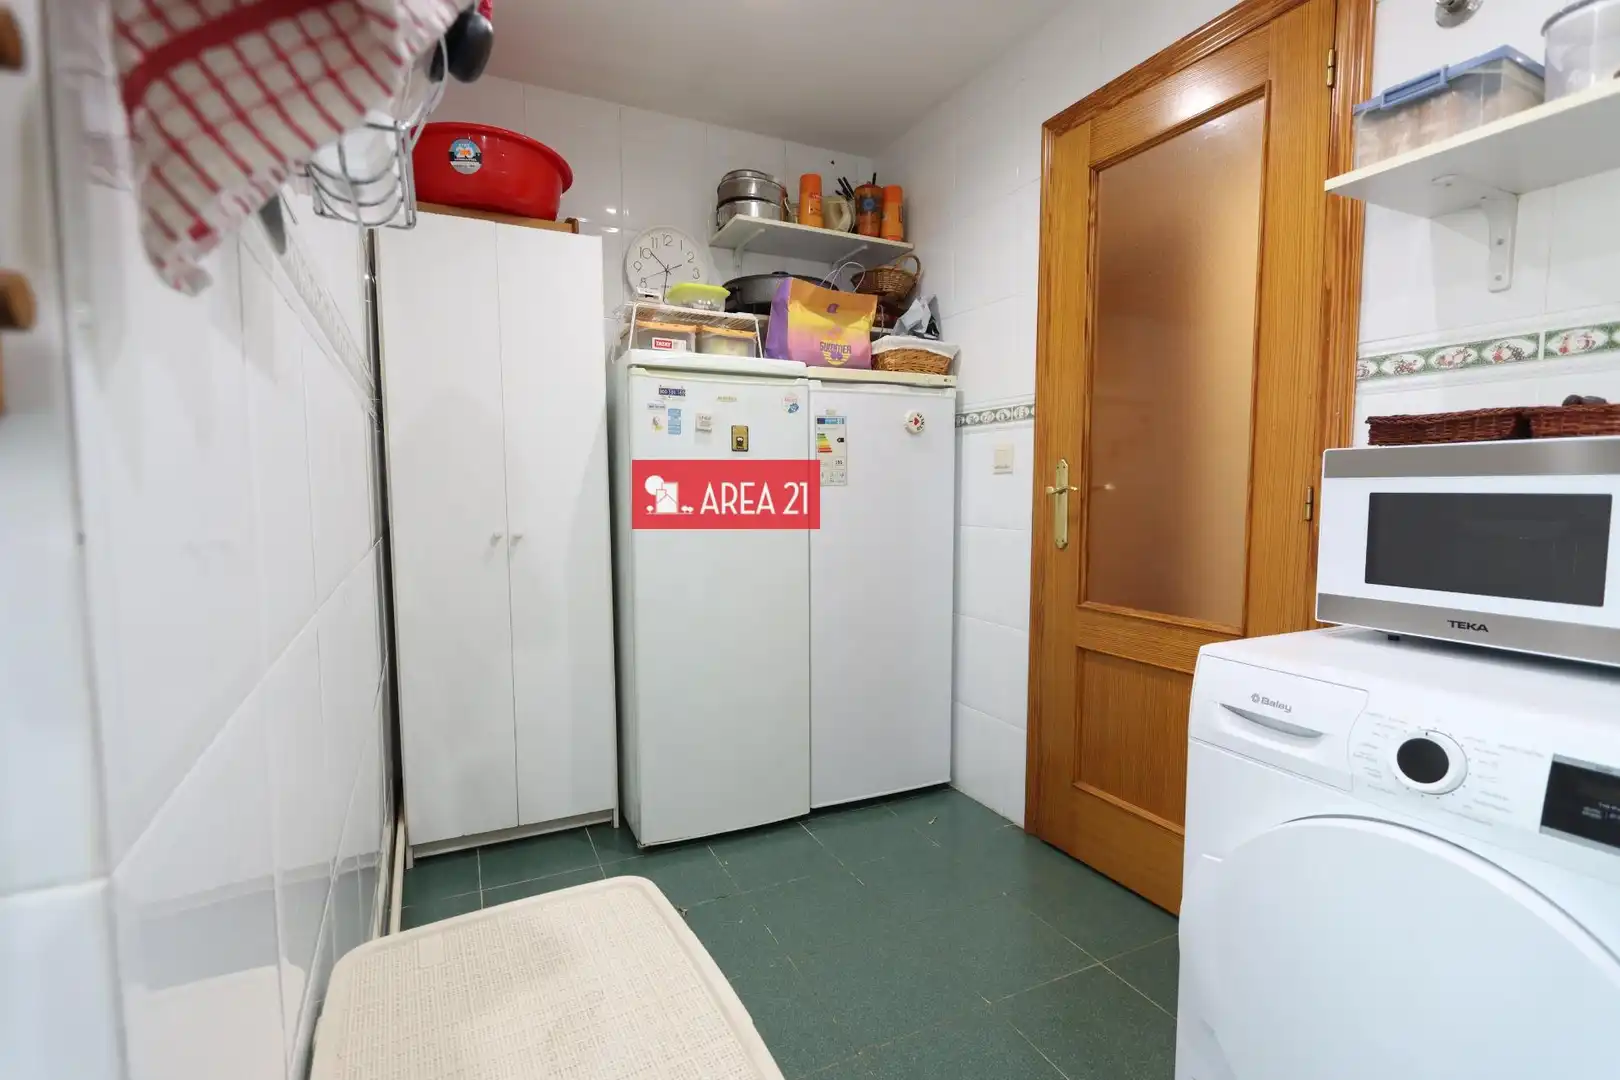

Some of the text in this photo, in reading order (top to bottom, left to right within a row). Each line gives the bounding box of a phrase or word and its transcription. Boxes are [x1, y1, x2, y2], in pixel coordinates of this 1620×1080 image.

[651, 237, 658, 249] 11
[662, 234, 674, 246] 12
[639, 246, 653, 260] 10
[686, 251, 695, 263] 2
[633, 260, 643, 274] 9
[692, 267, 700, 280] 3
[820, 341, 852, 355] SUMMER
[1447, 619, 1489, 633] TEKA
